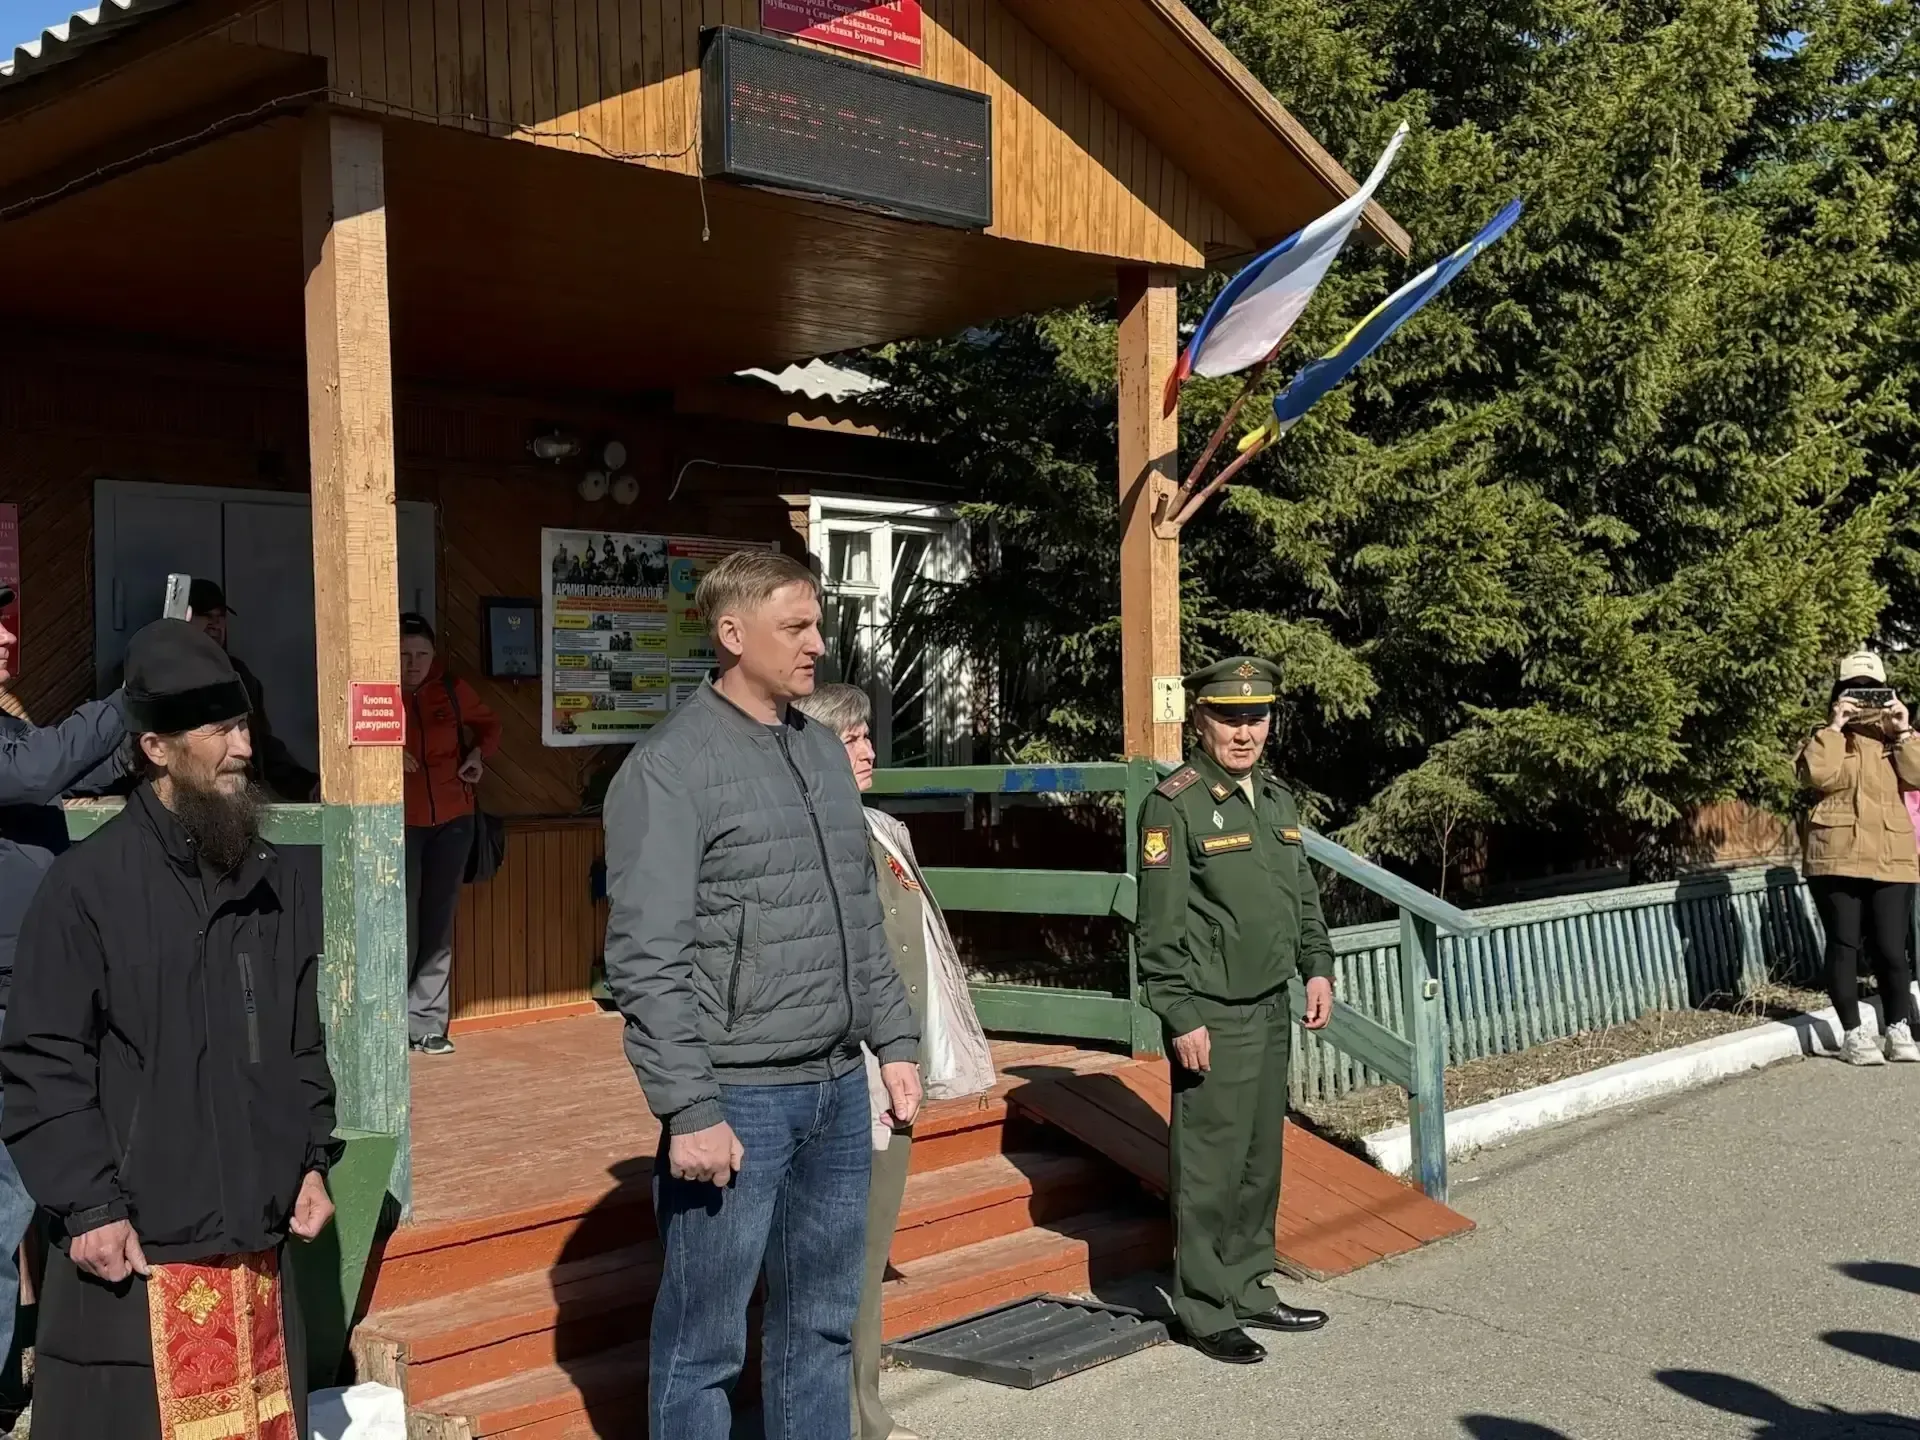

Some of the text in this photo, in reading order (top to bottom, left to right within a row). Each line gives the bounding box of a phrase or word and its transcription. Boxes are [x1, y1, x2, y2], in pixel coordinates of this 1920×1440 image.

[556, 583, 664, 600] АРМИЯ ПРОФЕССИОНАЛОВ
[362, 694, 393, 705] Кнопка
[361, 709, 394, 718] вызова
[355, 721, 401, 732] дежурного
